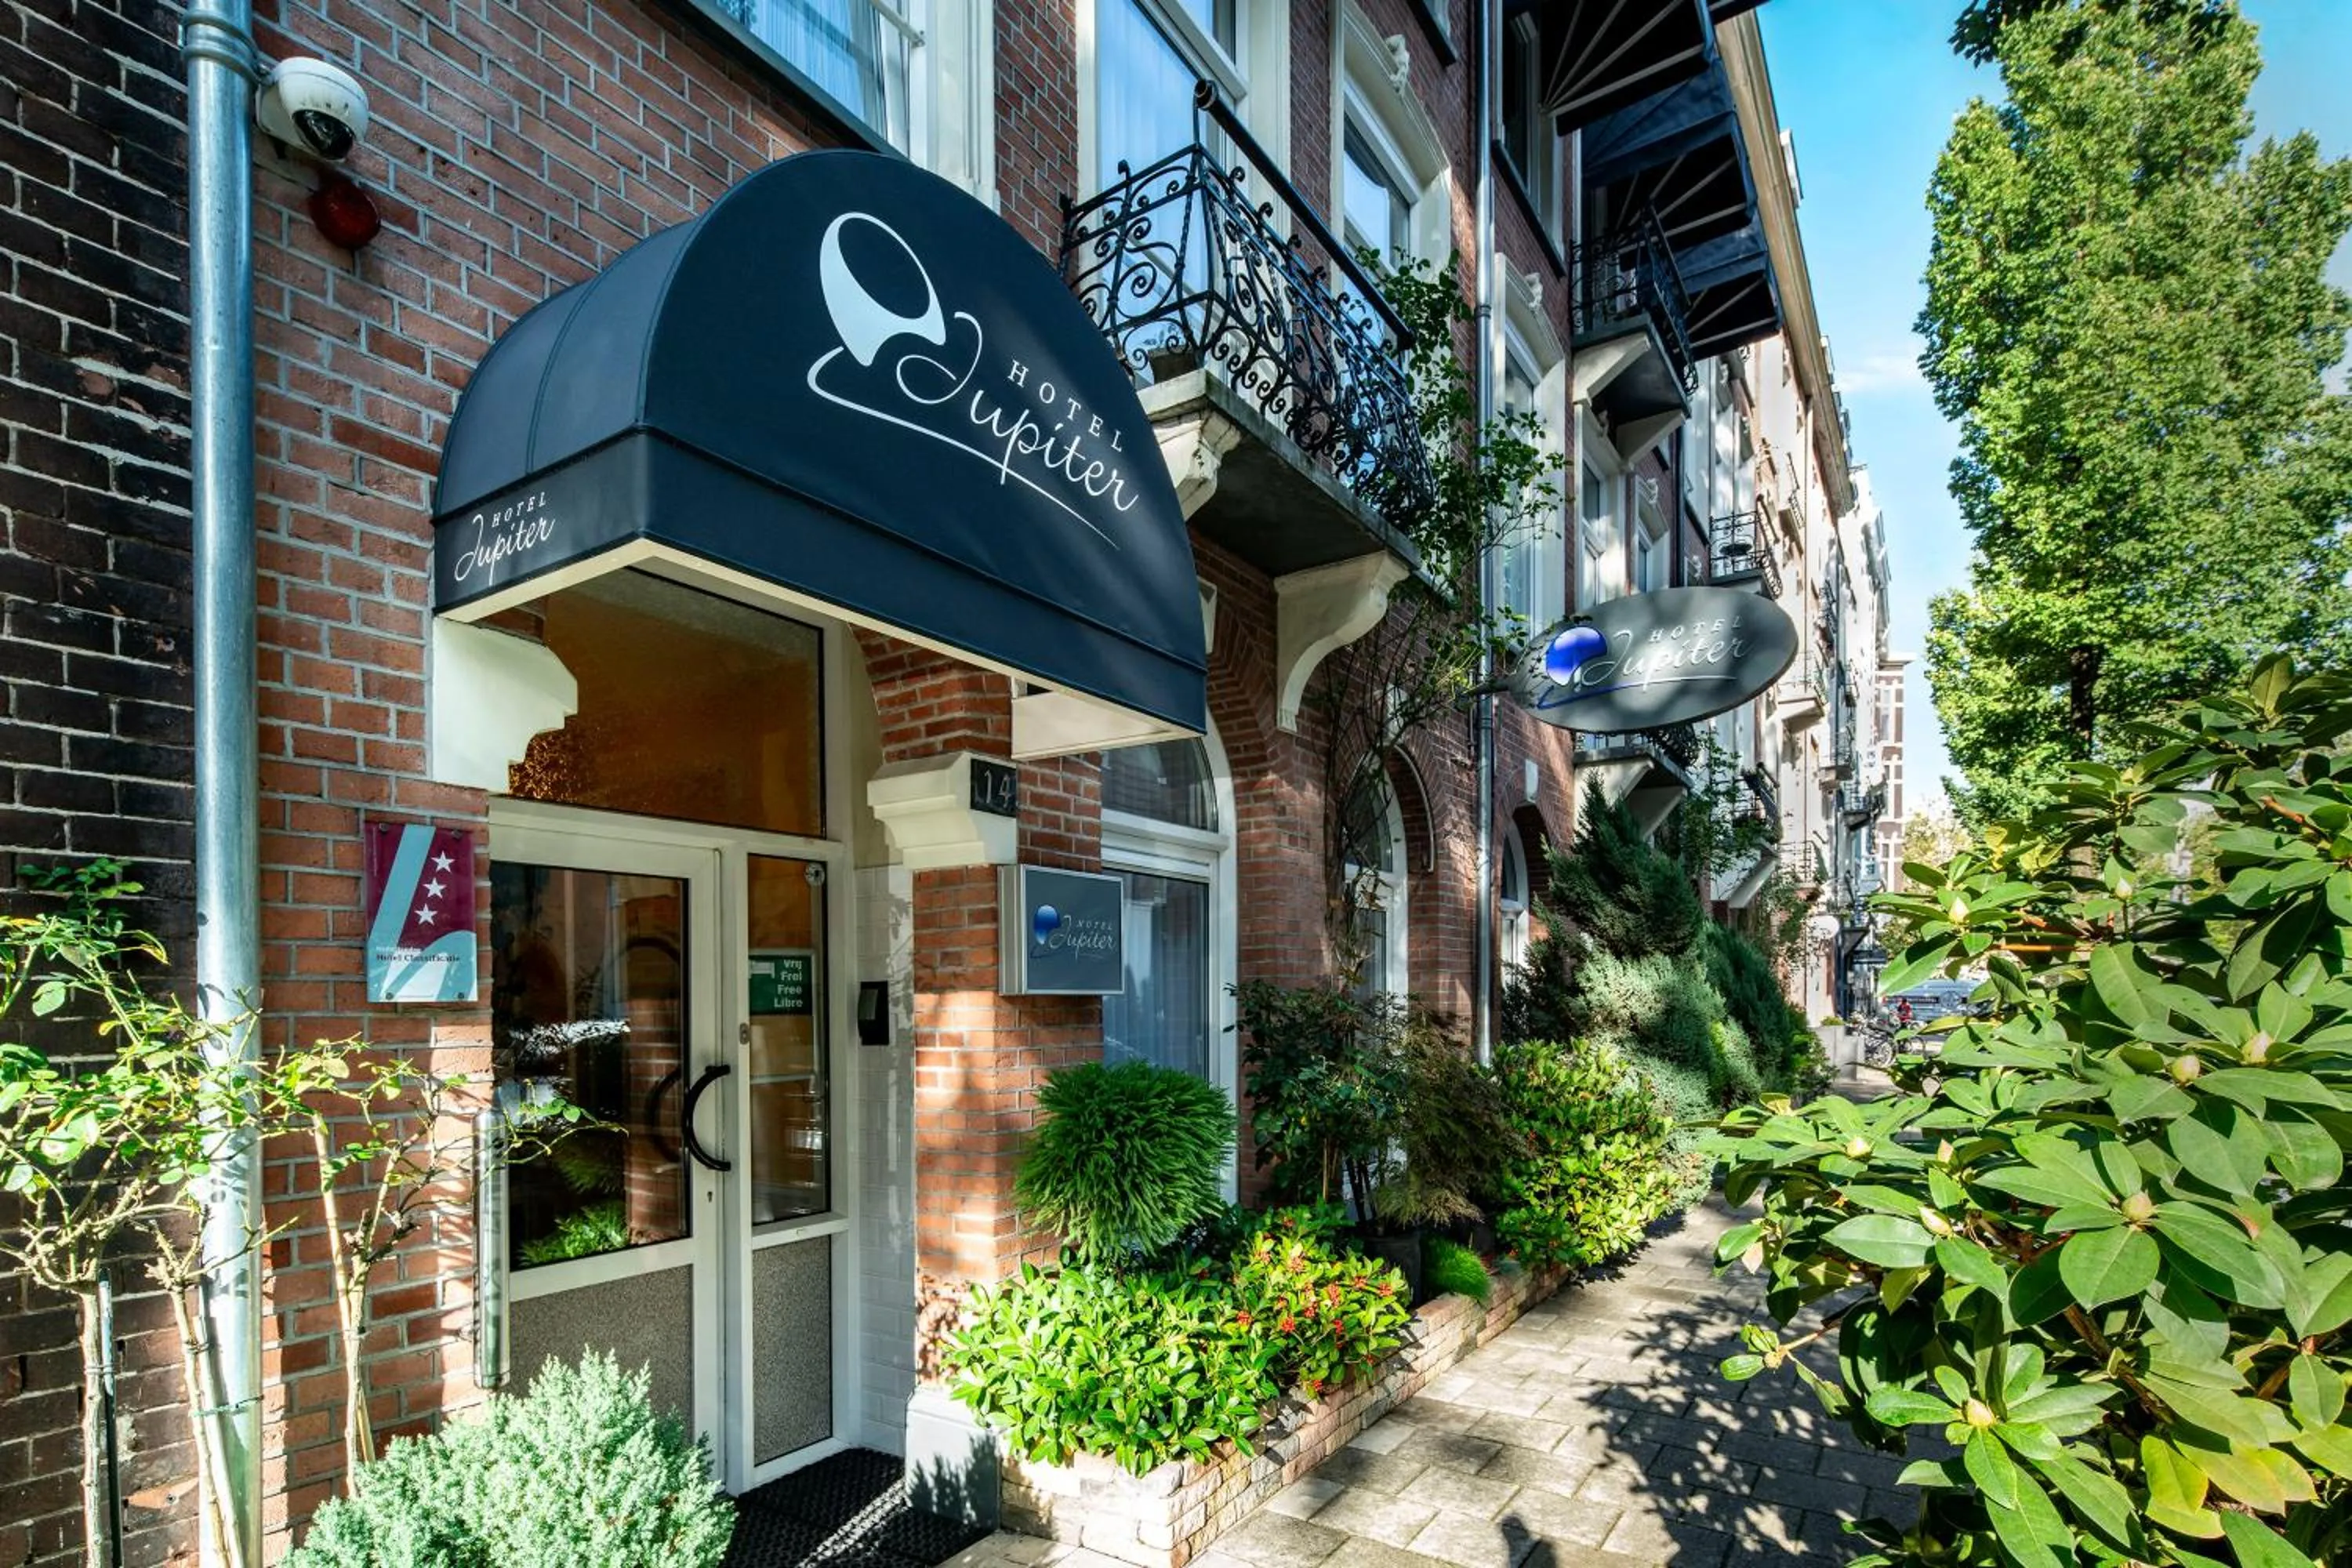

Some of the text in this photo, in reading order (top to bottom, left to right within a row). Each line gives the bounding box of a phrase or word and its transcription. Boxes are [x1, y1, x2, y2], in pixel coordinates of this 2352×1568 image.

[896, 310, 1139, 512] Jupiter
[1007, 361, 1123, 452] HOTEL
[492, 492, 546, 528] HOTEL
[454, 514, 556, 586] Jupiter
[1648, 615, 1744, 644] HOTEL
[1581, 629, 1754, 692] Jupiter
[984, 768, 1012, 808] 14
[1049, 914, 1116, 960] Jupiter
[1076, 919, 1112, 931] HOTEL
[777, 984, 803, 995] Free
[780, 971, 803, 981] Frei
[774, 997, 804, 1007] Libre
